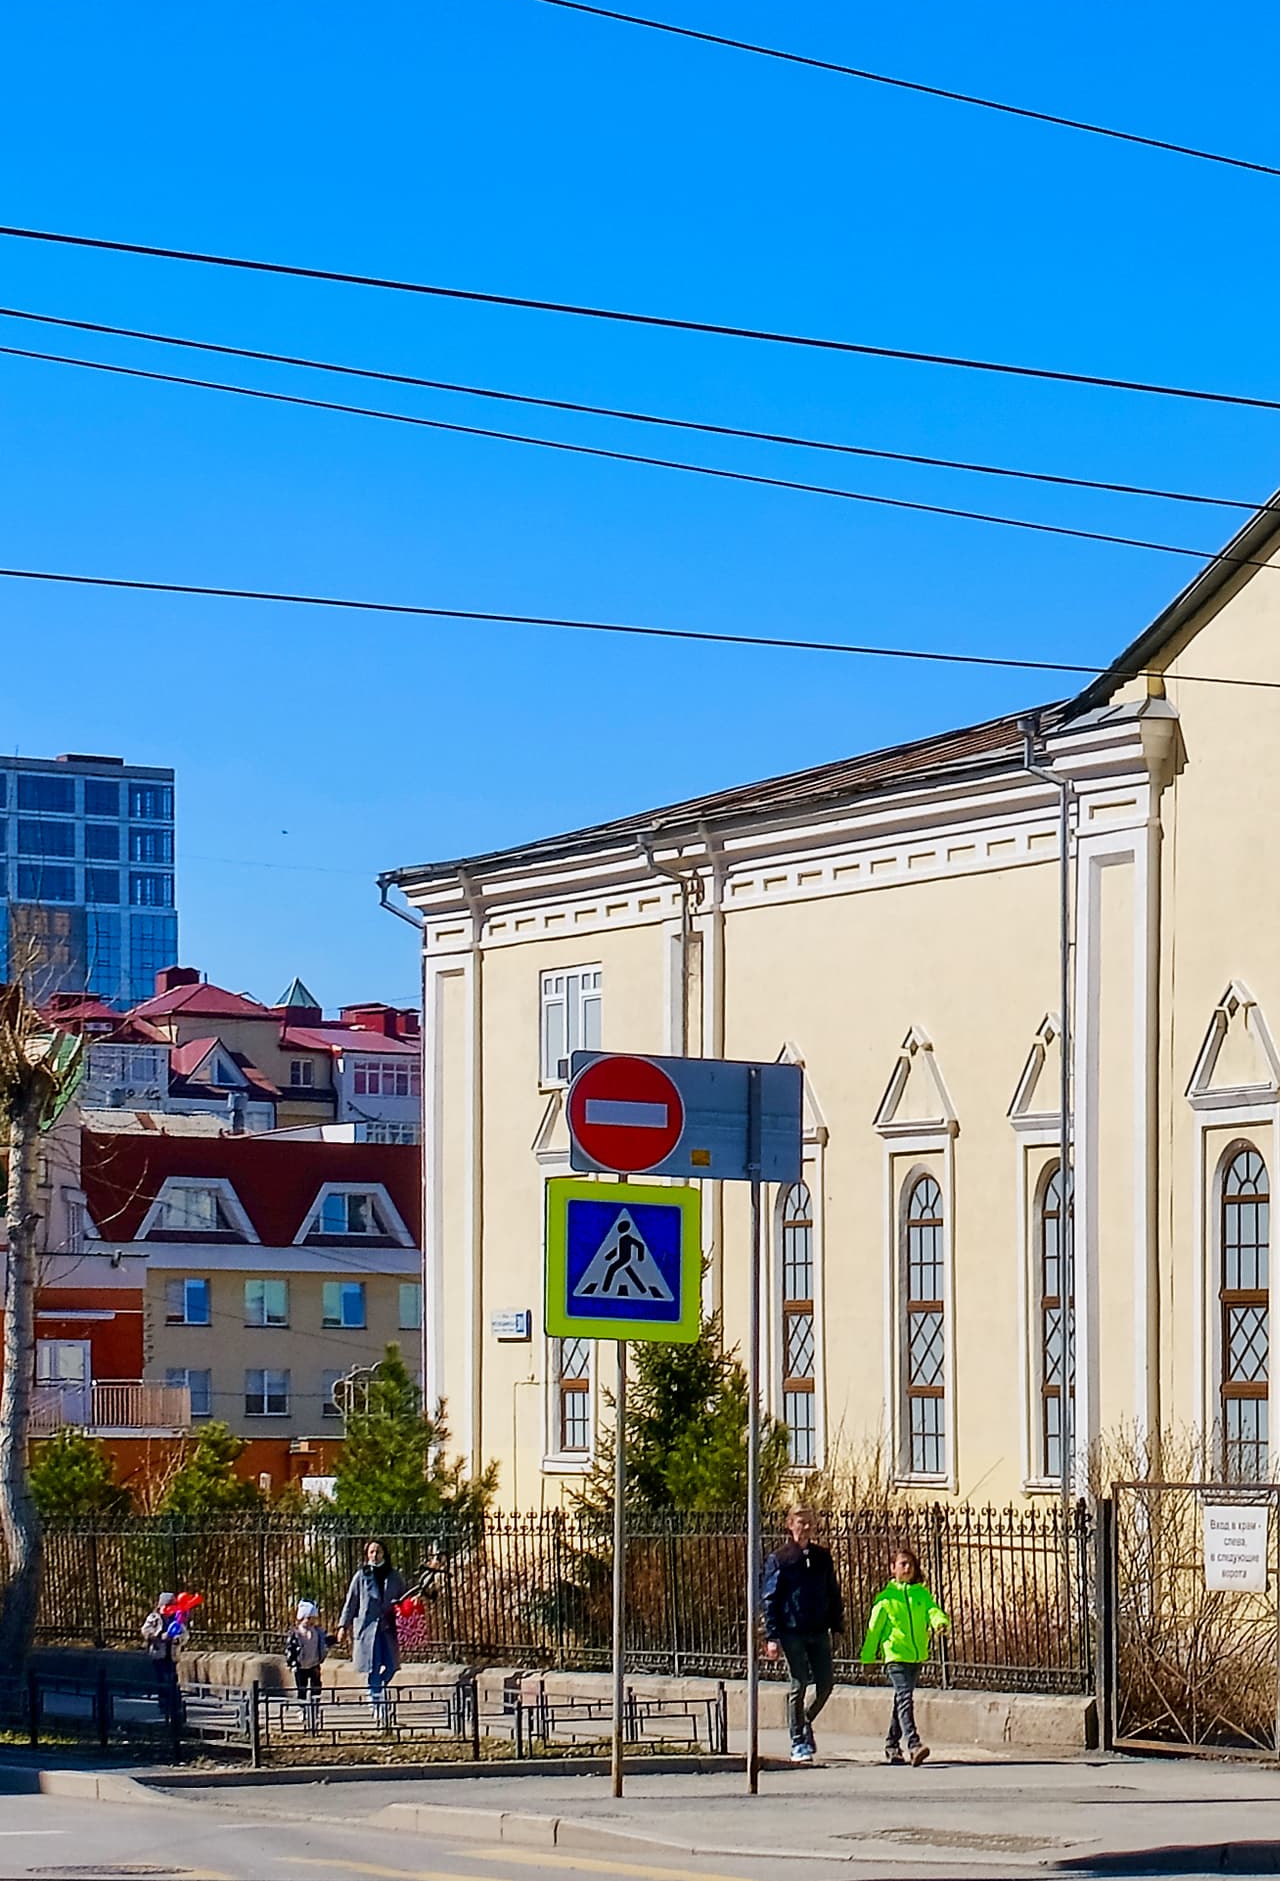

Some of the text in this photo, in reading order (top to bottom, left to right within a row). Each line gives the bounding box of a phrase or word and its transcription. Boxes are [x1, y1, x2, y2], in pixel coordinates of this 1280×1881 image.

[1210, 1519, 1230, 1530] Вход
[1238, 1522, 1256, 1532] храм
[1217, 1553, 1259, 1564] следующие
[1222, 1569, 1247, 1579] ворота
